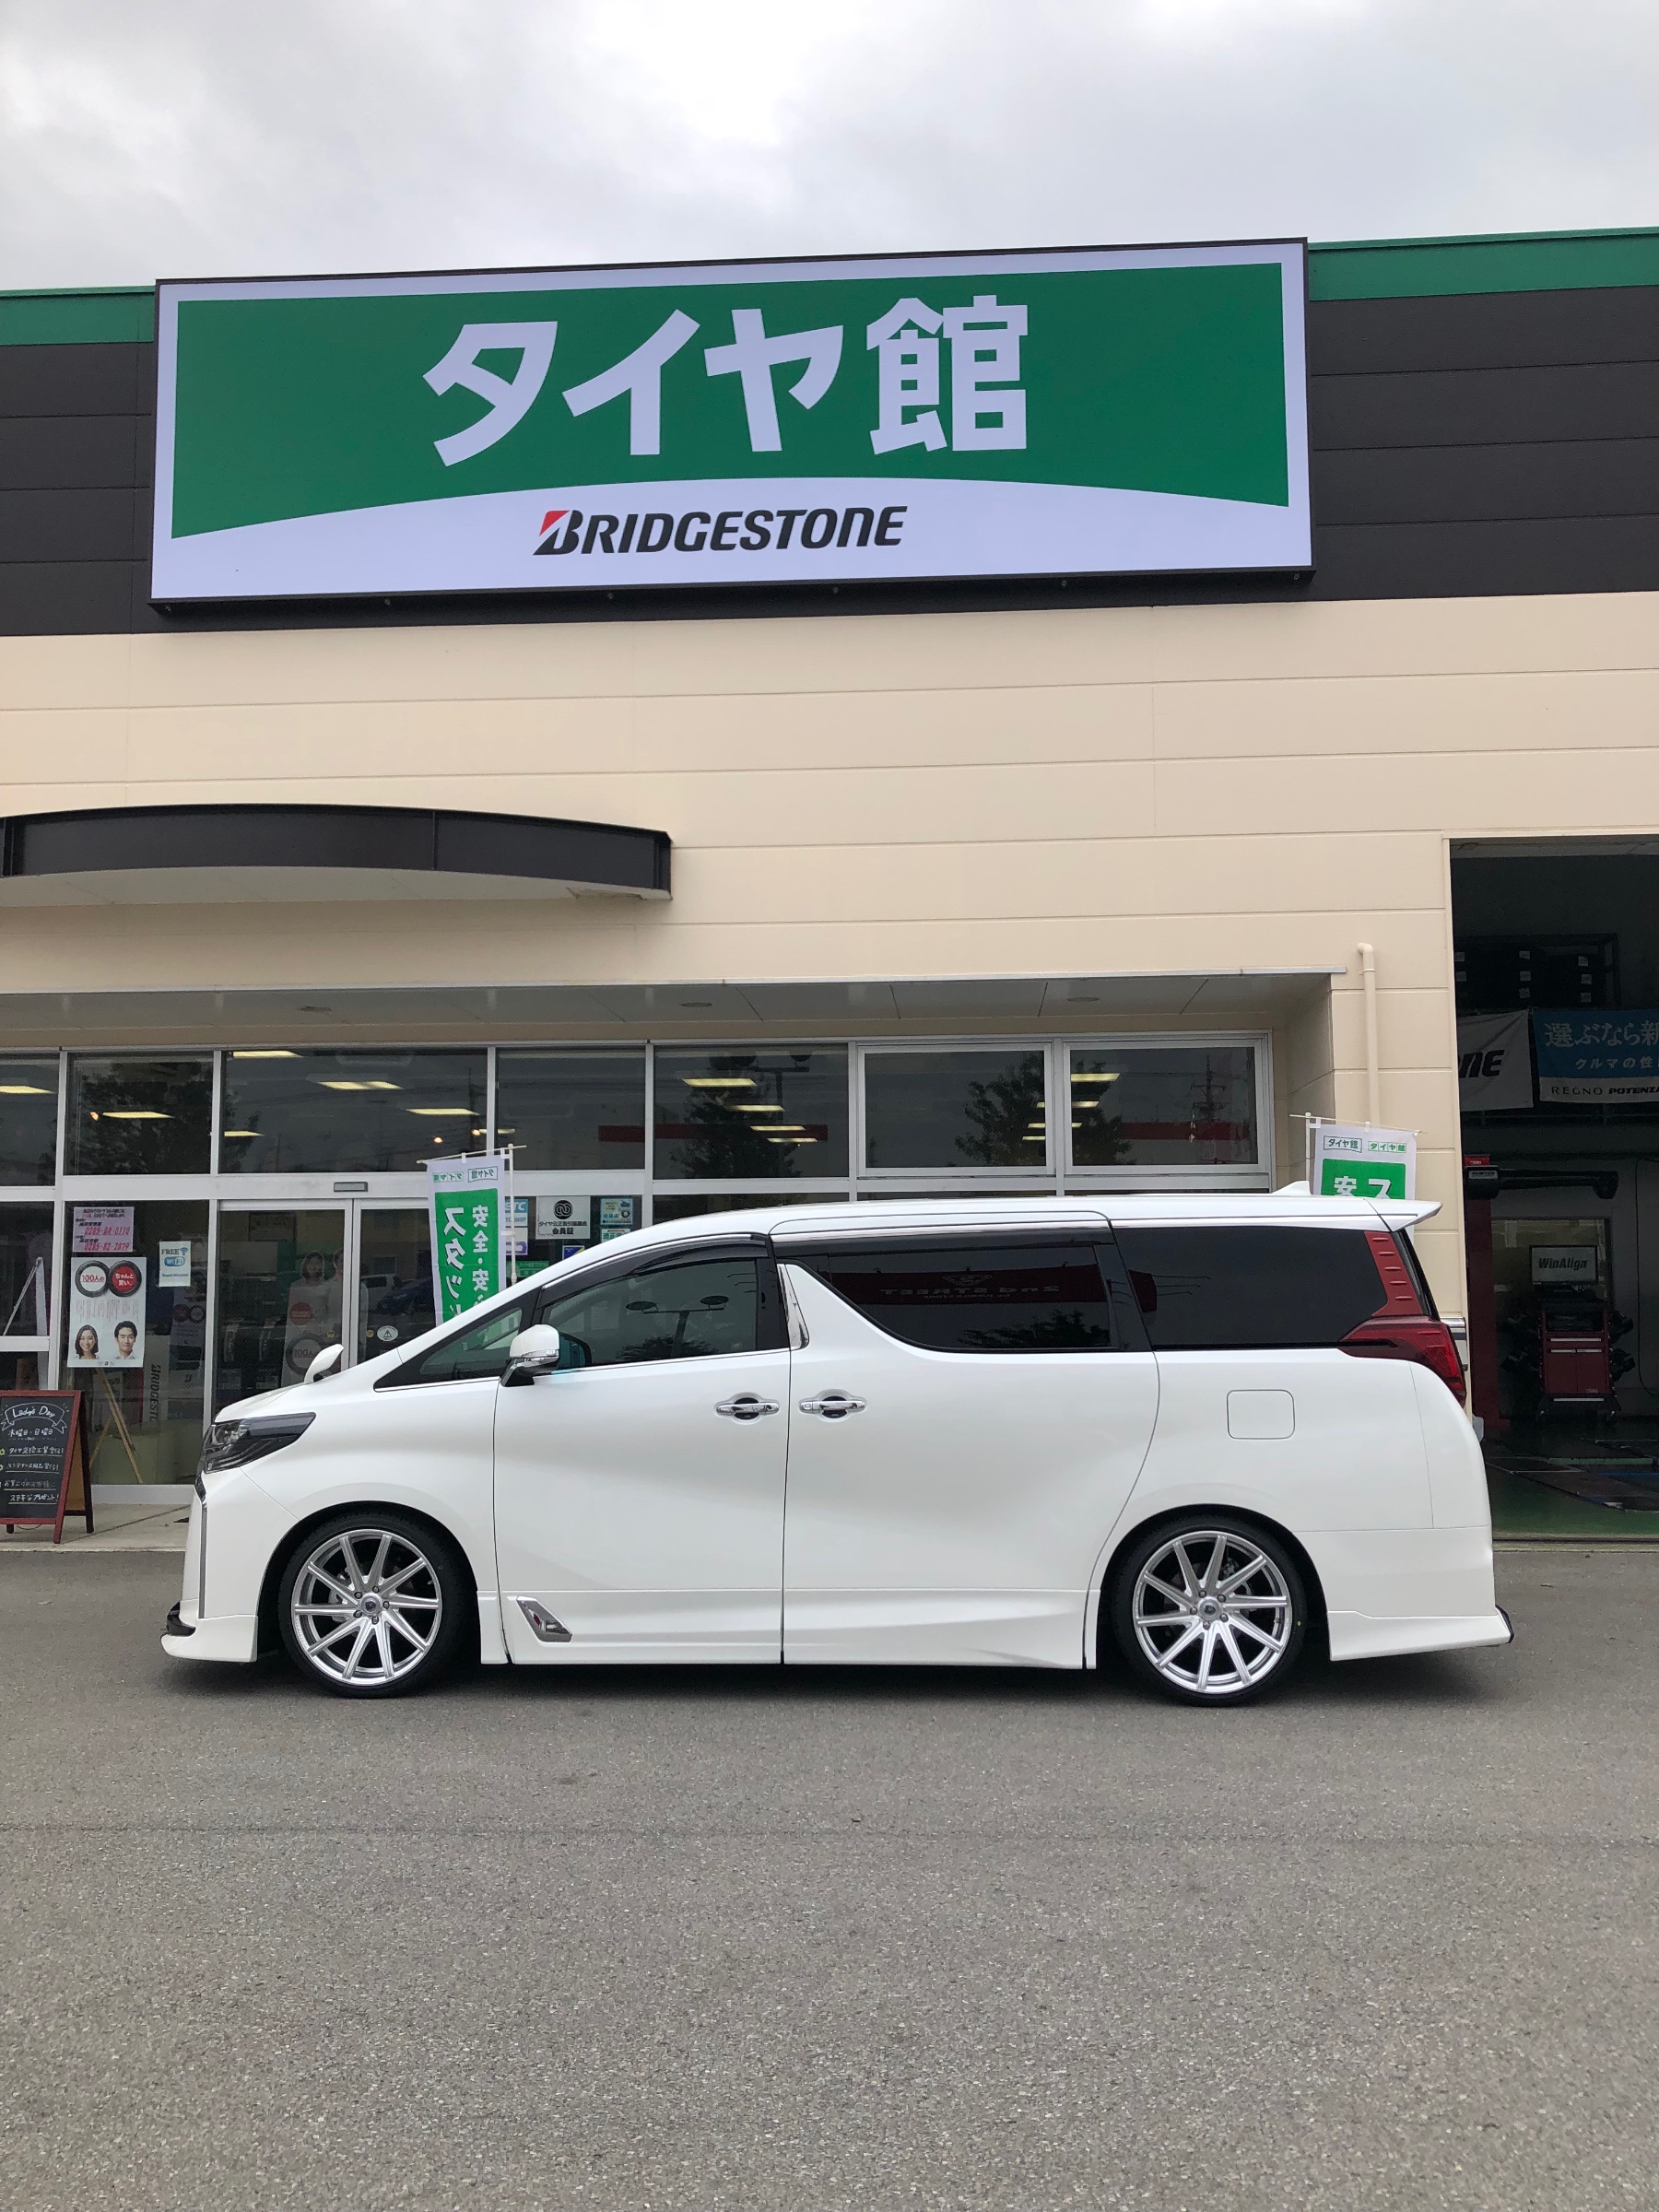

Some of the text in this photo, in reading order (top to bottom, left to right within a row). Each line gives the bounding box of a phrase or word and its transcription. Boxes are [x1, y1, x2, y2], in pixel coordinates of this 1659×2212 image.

[422, 295, 1028, 467] タイヤ館
[533, 506, 908, 555] BRIDGESTONE
[1458, 1050, 1505, 1078] NE
[1576, 1055, 1659, 1069] クルマの性
[1552, 1087, 1603, 1095] REGNO
[1328, 1138, 1358, 1148] タイヤ館
[1538, 1257, 1587, 1271] WinAlign
[39, 1406, 56, 1418] Day
